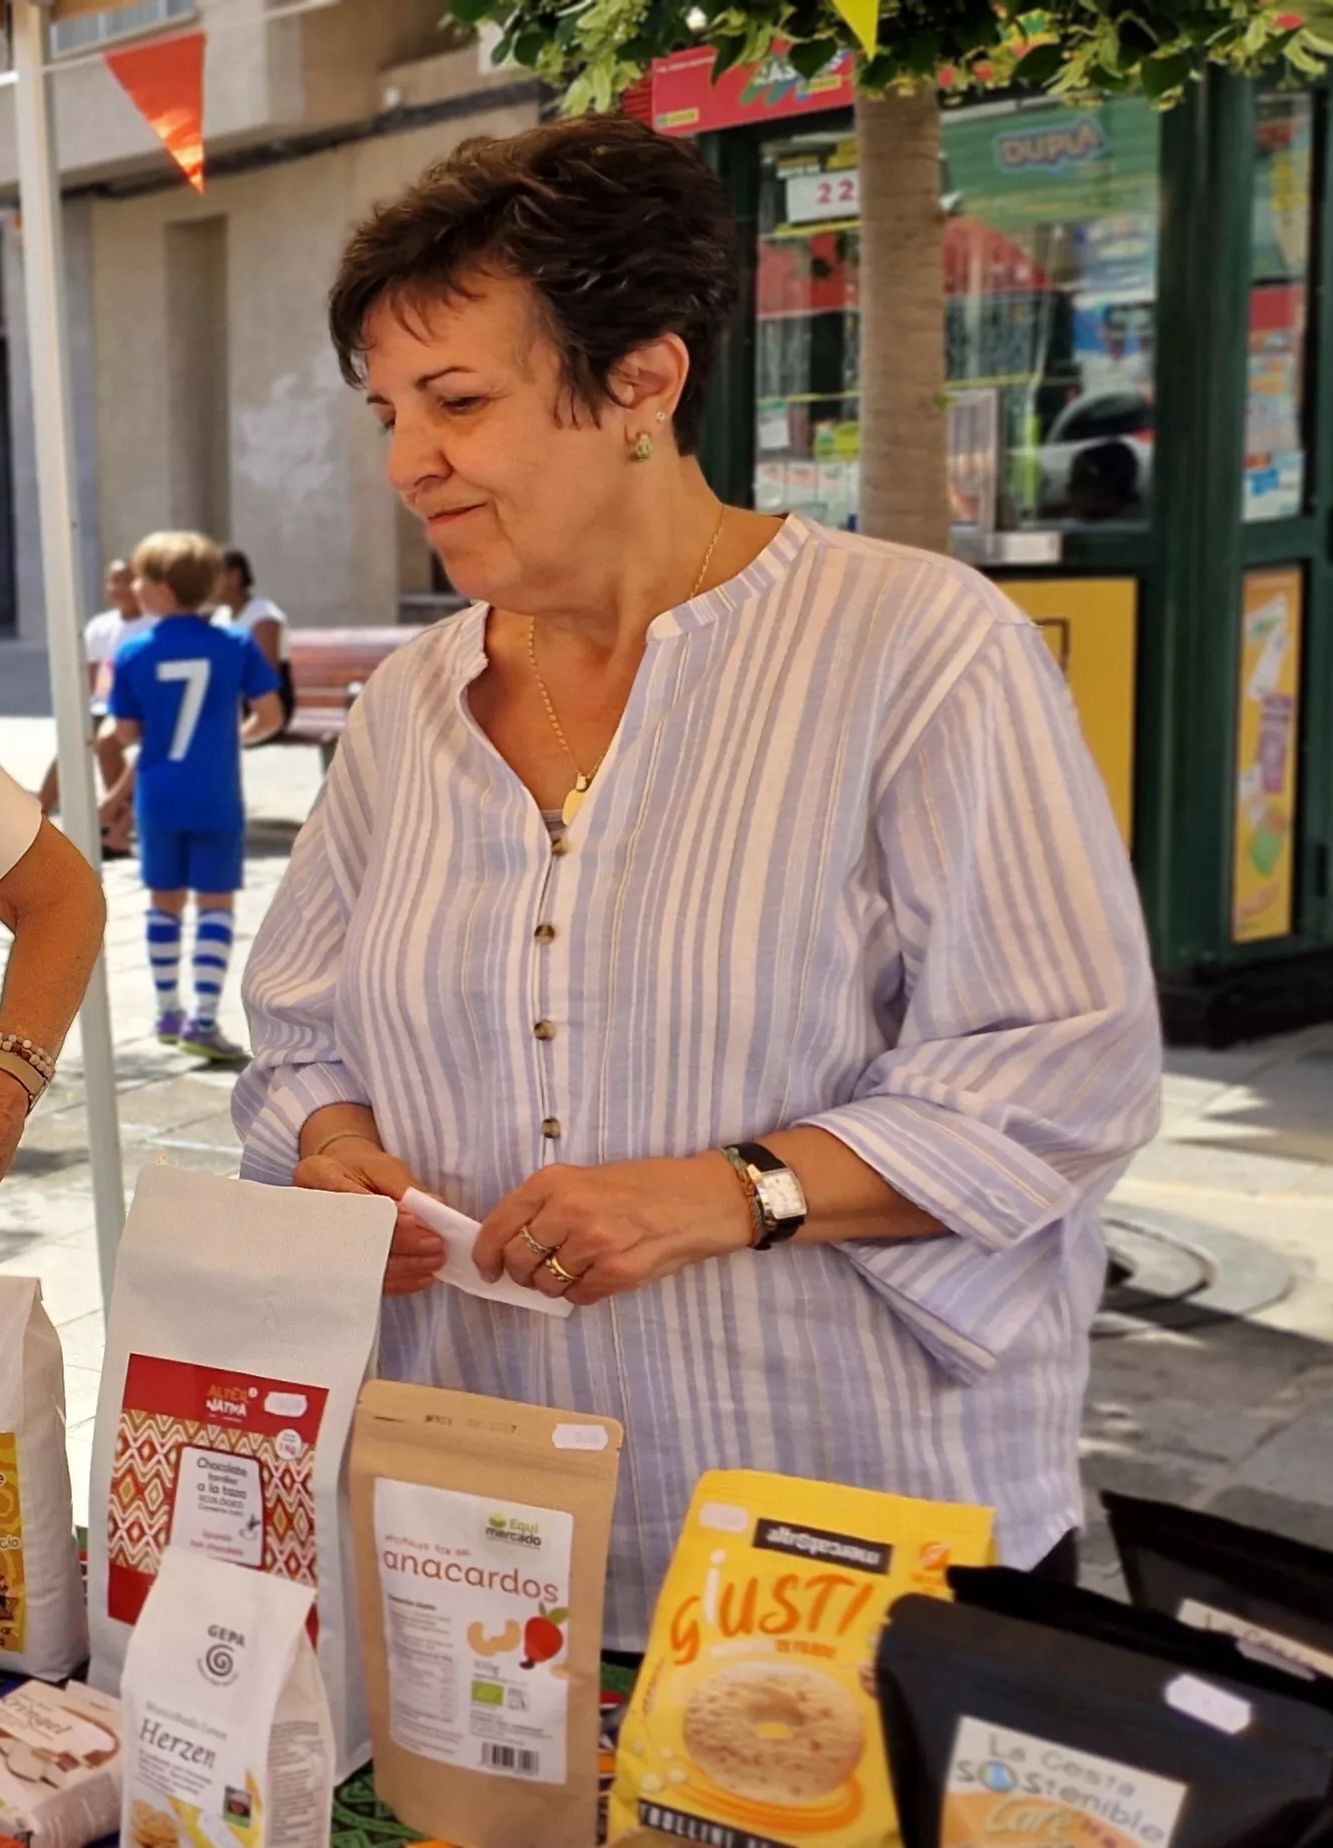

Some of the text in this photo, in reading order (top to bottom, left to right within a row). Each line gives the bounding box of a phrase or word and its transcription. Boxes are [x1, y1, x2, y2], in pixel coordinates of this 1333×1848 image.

[155, 658, 210, 760] 7
[197, 1457, 248, 1477] Chocolate
[197, 1482, 205, 1492] a
[485, 1526, 542, 1547] mercado
[509, 1518, 538, 1534] Equi
[382, 1549, 559, 1604] anacardos
[207, 1624, 245, 1648] GEPA
[139, 1717, 216, 1769] Herzen
[989, 1733, 1136, 1799] La Cesta
